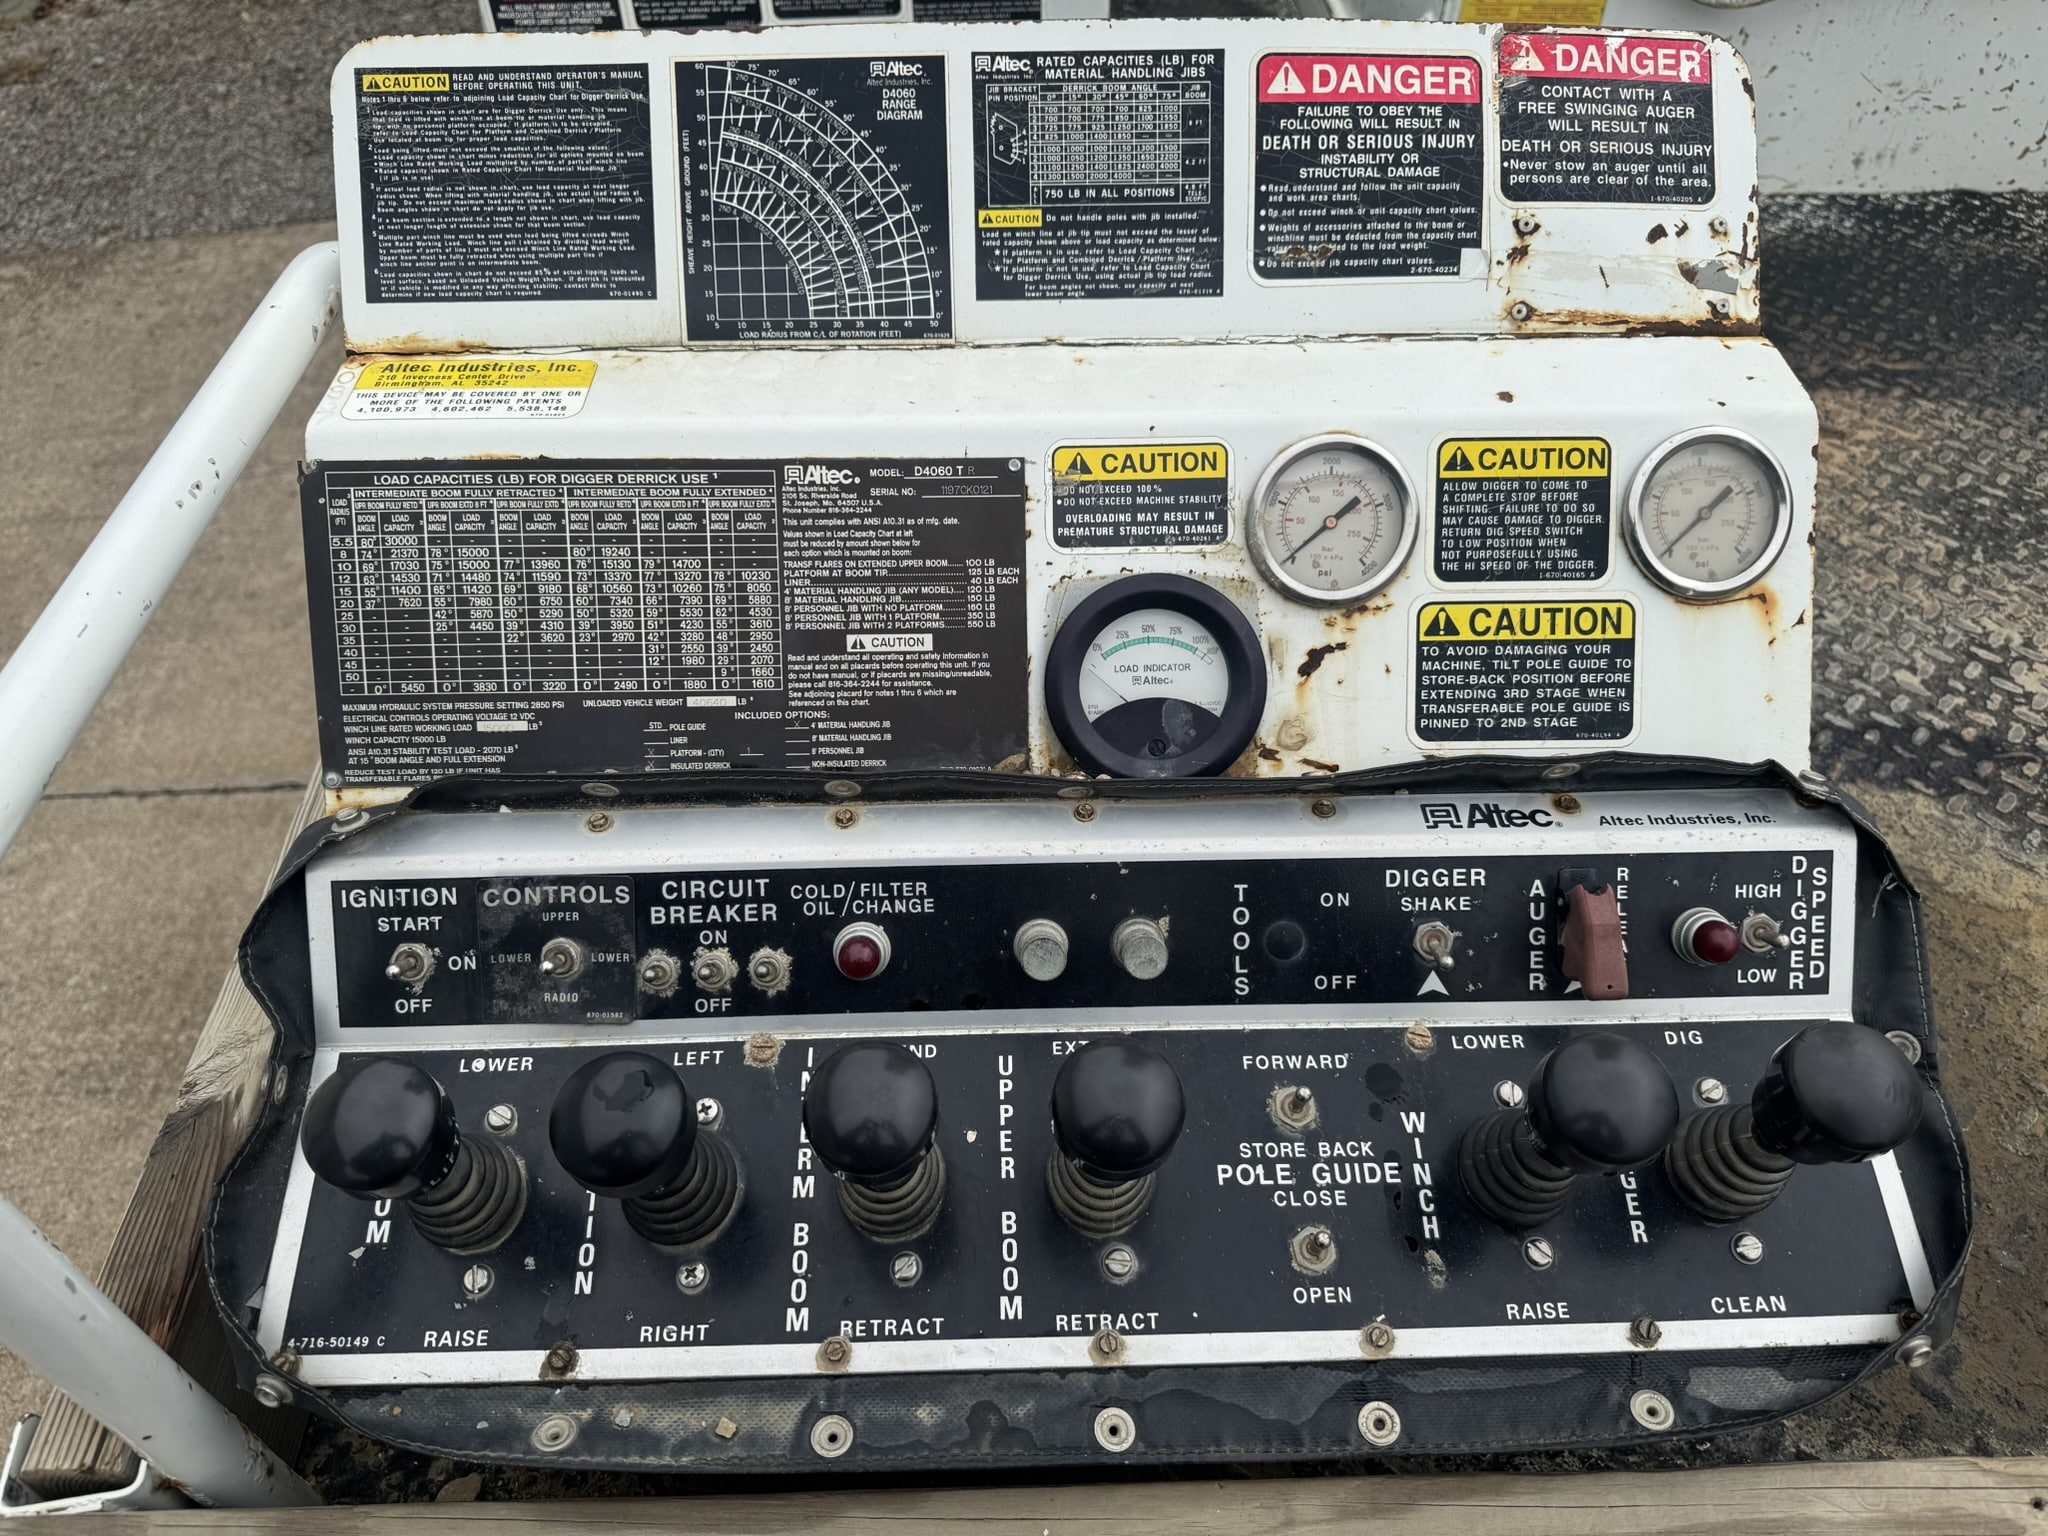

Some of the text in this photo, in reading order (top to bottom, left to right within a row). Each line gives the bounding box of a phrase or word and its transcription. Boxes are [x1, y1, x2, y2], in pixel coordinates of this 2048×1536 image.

[993, 56, 1032, 73] Altec
[1037, 55, 1214, 66] RATED CAPACITIES (LB) FOR
[1556, 44, 1701, 78] DANGER
[886, 61, 922, 76] Altec
[1046, 67, 1205, 79] MATERIAL HANDLING JIBS
[383, 77, 446, 88] CAUTION
[538, 81, 555, 89] THIS
[1313, 64, 1473, 95] DANGER
[883, 89, 915, 98] D4060
[1542, 86, 1671, 101] CONTACT WITH A
[883, 100, 916, 109] RANGE
[1298, 106, 1442, 116] FAILURE TO OBEY THE
[1519, 102, 1694, 118] FREE SWINGING AUGER
[877, 110, 922, 120] DIAGRAM
[1281, 118, 1459, 129] FOLLOWING WILL RESULT IN
[1548, 119, 1668, 134] WILL RESULT IN
[1263, 134, 1475, 149] DEATH OR SERIOUS INJURY
[1321, 153, 1418, 164] INSTABILITY OR
[1300, 167, 1439, 178] STRUCTURAL DAMAGE
[1511, 159, 1706, 174] Never stow an auger until all
[1046, 188, 1174, 198] 750 LB IN ALL POSITIONS
[996, 215, 1038, 223] CAUTION
[382, 363, 581, 373] Altec Industries, Inc.
[1101, 452, 1217, 473] CAUTION
[1479, 448, 1605, 470] CAUTION
[803, 465, 853, 484] Altec
[870, 469, 904, 477] MODEL:
[915, 466, 952, 476] D4060
[956, 466, 963, 475] T
[374, 474, 708, 485] LOAD CAPACITIES (LB) FOR DIGGER DERRICK USE
[871, 488, 899, 496] SERIAL
[902, 488, 917, 496] NO:
[1066, 512, 1214, 523] OVERLOADING MAY RESULT IN
[1058, 525, 1223, 536] PREMATURE STRUCTURAL DAMAGE
[1469, 607, 1621, 636] CAUTION
[872, 637, 924, 647] CAUTION
[1144, 663, 1190, 672] INDICATOR
[1143, 676, 1169, 685] Altec
[1467, 803, 1556, 829] Altec
[1599, 812, 1777, 827] Altec Industries, Inc.
[1386, 869, 1485, 887] DIGGER
[483, 886, 629, 906] CONTROLS
[662, 879, 769, 899] CIRCUIT
[1736, 884, 1780, 898] HIGH
[342, 888, 456, 907] IGNITION
[1321, 893, 1348, 906] ON
[1402, 897, 1470, 911] SHAKE
[543, 912, 579, 921] UPPER
[651, 904, 776, 924] BREAKER
[378, 917, 442, 931] START
[1790, 855, 1806, 990] DIGGER
[1810, 867, 1828, 980] SPEED
[700, 930, 726, 944] ON
[1233, 885, 1249, 995] TOOLS
[1529, 880, 1546, 990] AUGER
[449, 956, 476, 970] ON
[490, 953, 532, 963] LOWER
[591, 953, 631, 962] LOWER
[1315, 976, 1356, 989] OFF
[1738, 969, 1776, 983] LOW
[543, 992, 579, 1002] RADIO
[395, 999, 432, 1013] OFF
[695, 998, 731, 1012] OFF
[1452, 1035, 1524, 1049] LOWER
[1665, 1031, 1702, 1044] DIG
[460, 1057, 533, 1072] LOWER
[674, 1051, 723, 1065] LEFT
[1243, 1054, 1348, 1069] FORWARD
[1240, 1142, 1374, 1158] STORE BACK
[1218, 1163, 1401, 1186] POLE GUIDE
[1401, 1112, 1440, 1240] WINCH
[999, 1055, 1022, 1319] UPPER BOOM
[1274, 1190, 1347, 1206] CLOSE
[786, 1223, 808, 1331] BOOM
[1294, 1287, 1351, 1303] OPEN
[1507, 1303, 1569, 1319] RAISE
[1712, 1296, 1786, 1313] CLEAN
[840, 1317, 945, 1337] RETRACT
[1056, 1313, 1158, 1333] RETRACT
[424, 1330, 488, 1347] RAISE
[640, 1325, 709, 1342] RIGHT
[286, 1336, 386, 1349] 4-716-50149 C
